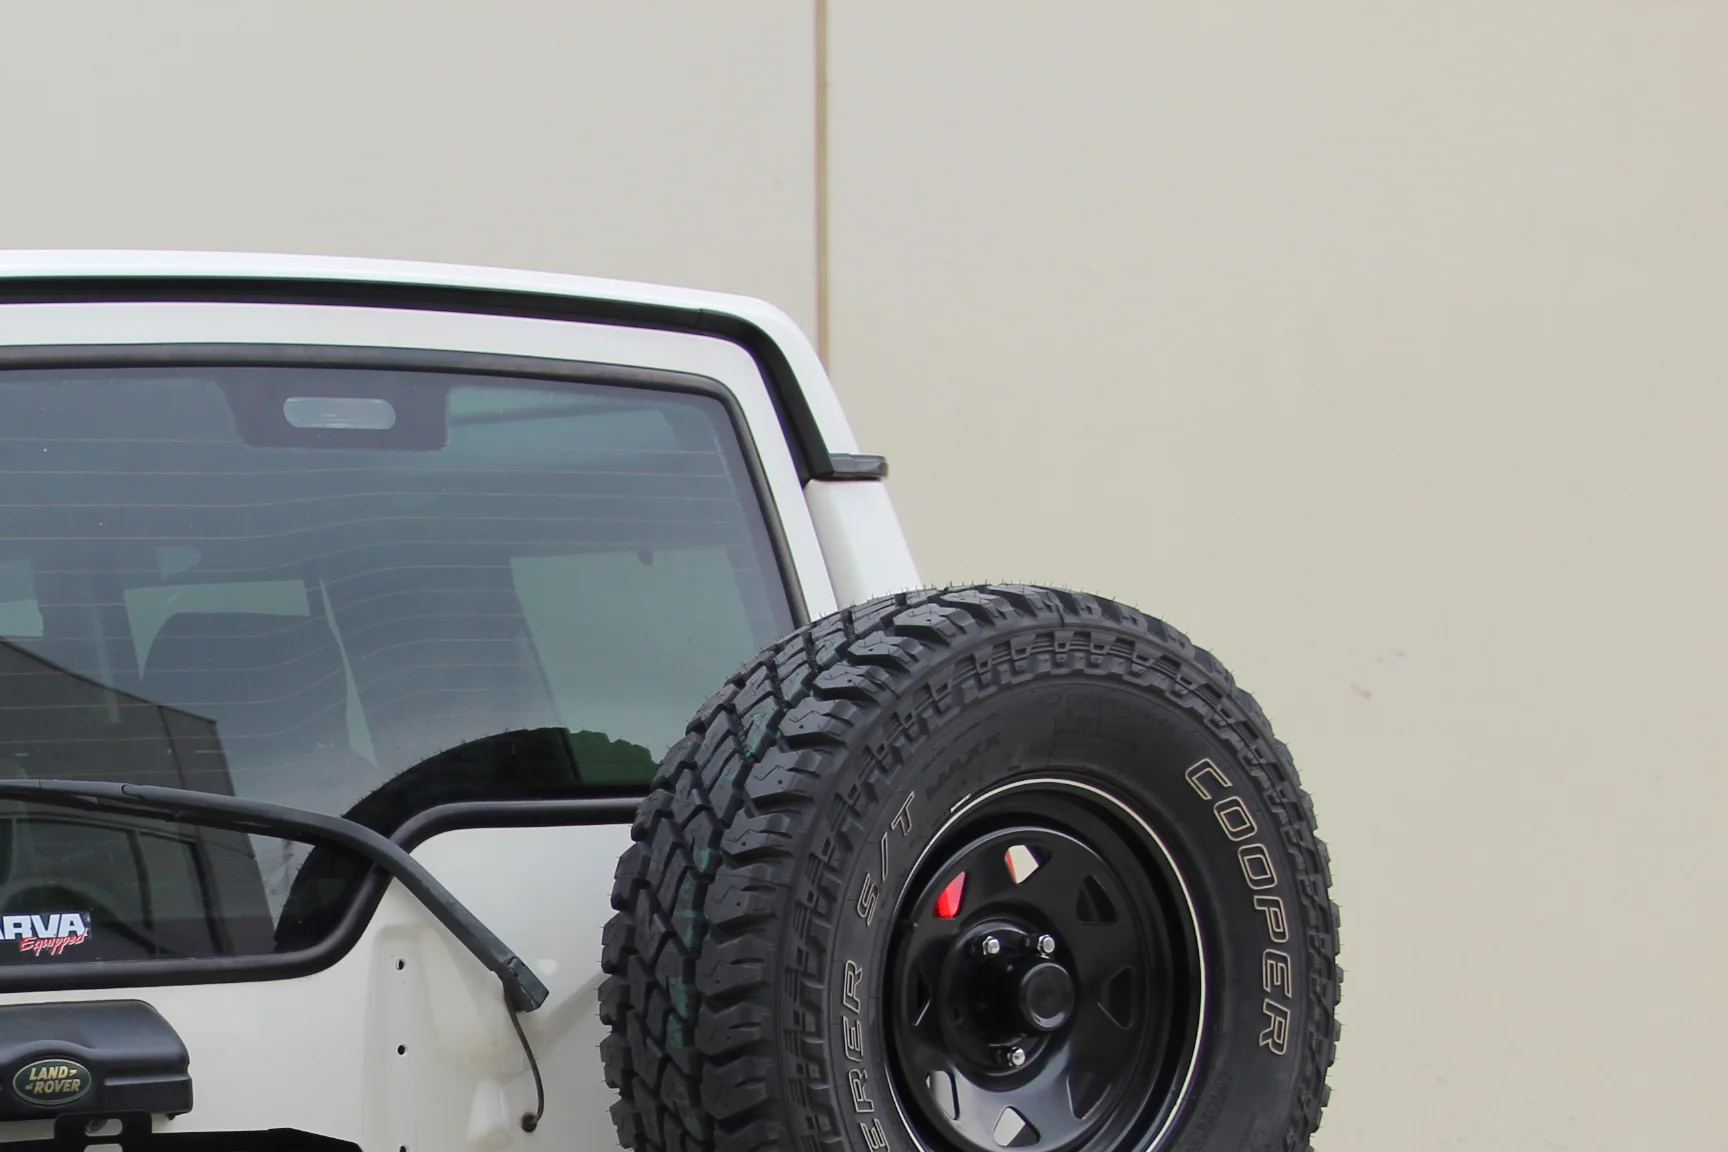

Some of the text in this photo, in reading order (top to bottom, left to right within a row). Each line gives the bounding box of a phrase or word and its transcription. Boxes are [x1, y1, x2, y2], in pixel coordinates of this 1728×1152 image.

[856, 790, 916, 927] S/T
[1184, 757, 1293, 1056] COOPER
[19, 927, 88, 957] Equipped
[29, 1065, 68, 1081] LAND
[33, 1078, 81, 1094] ROVER
